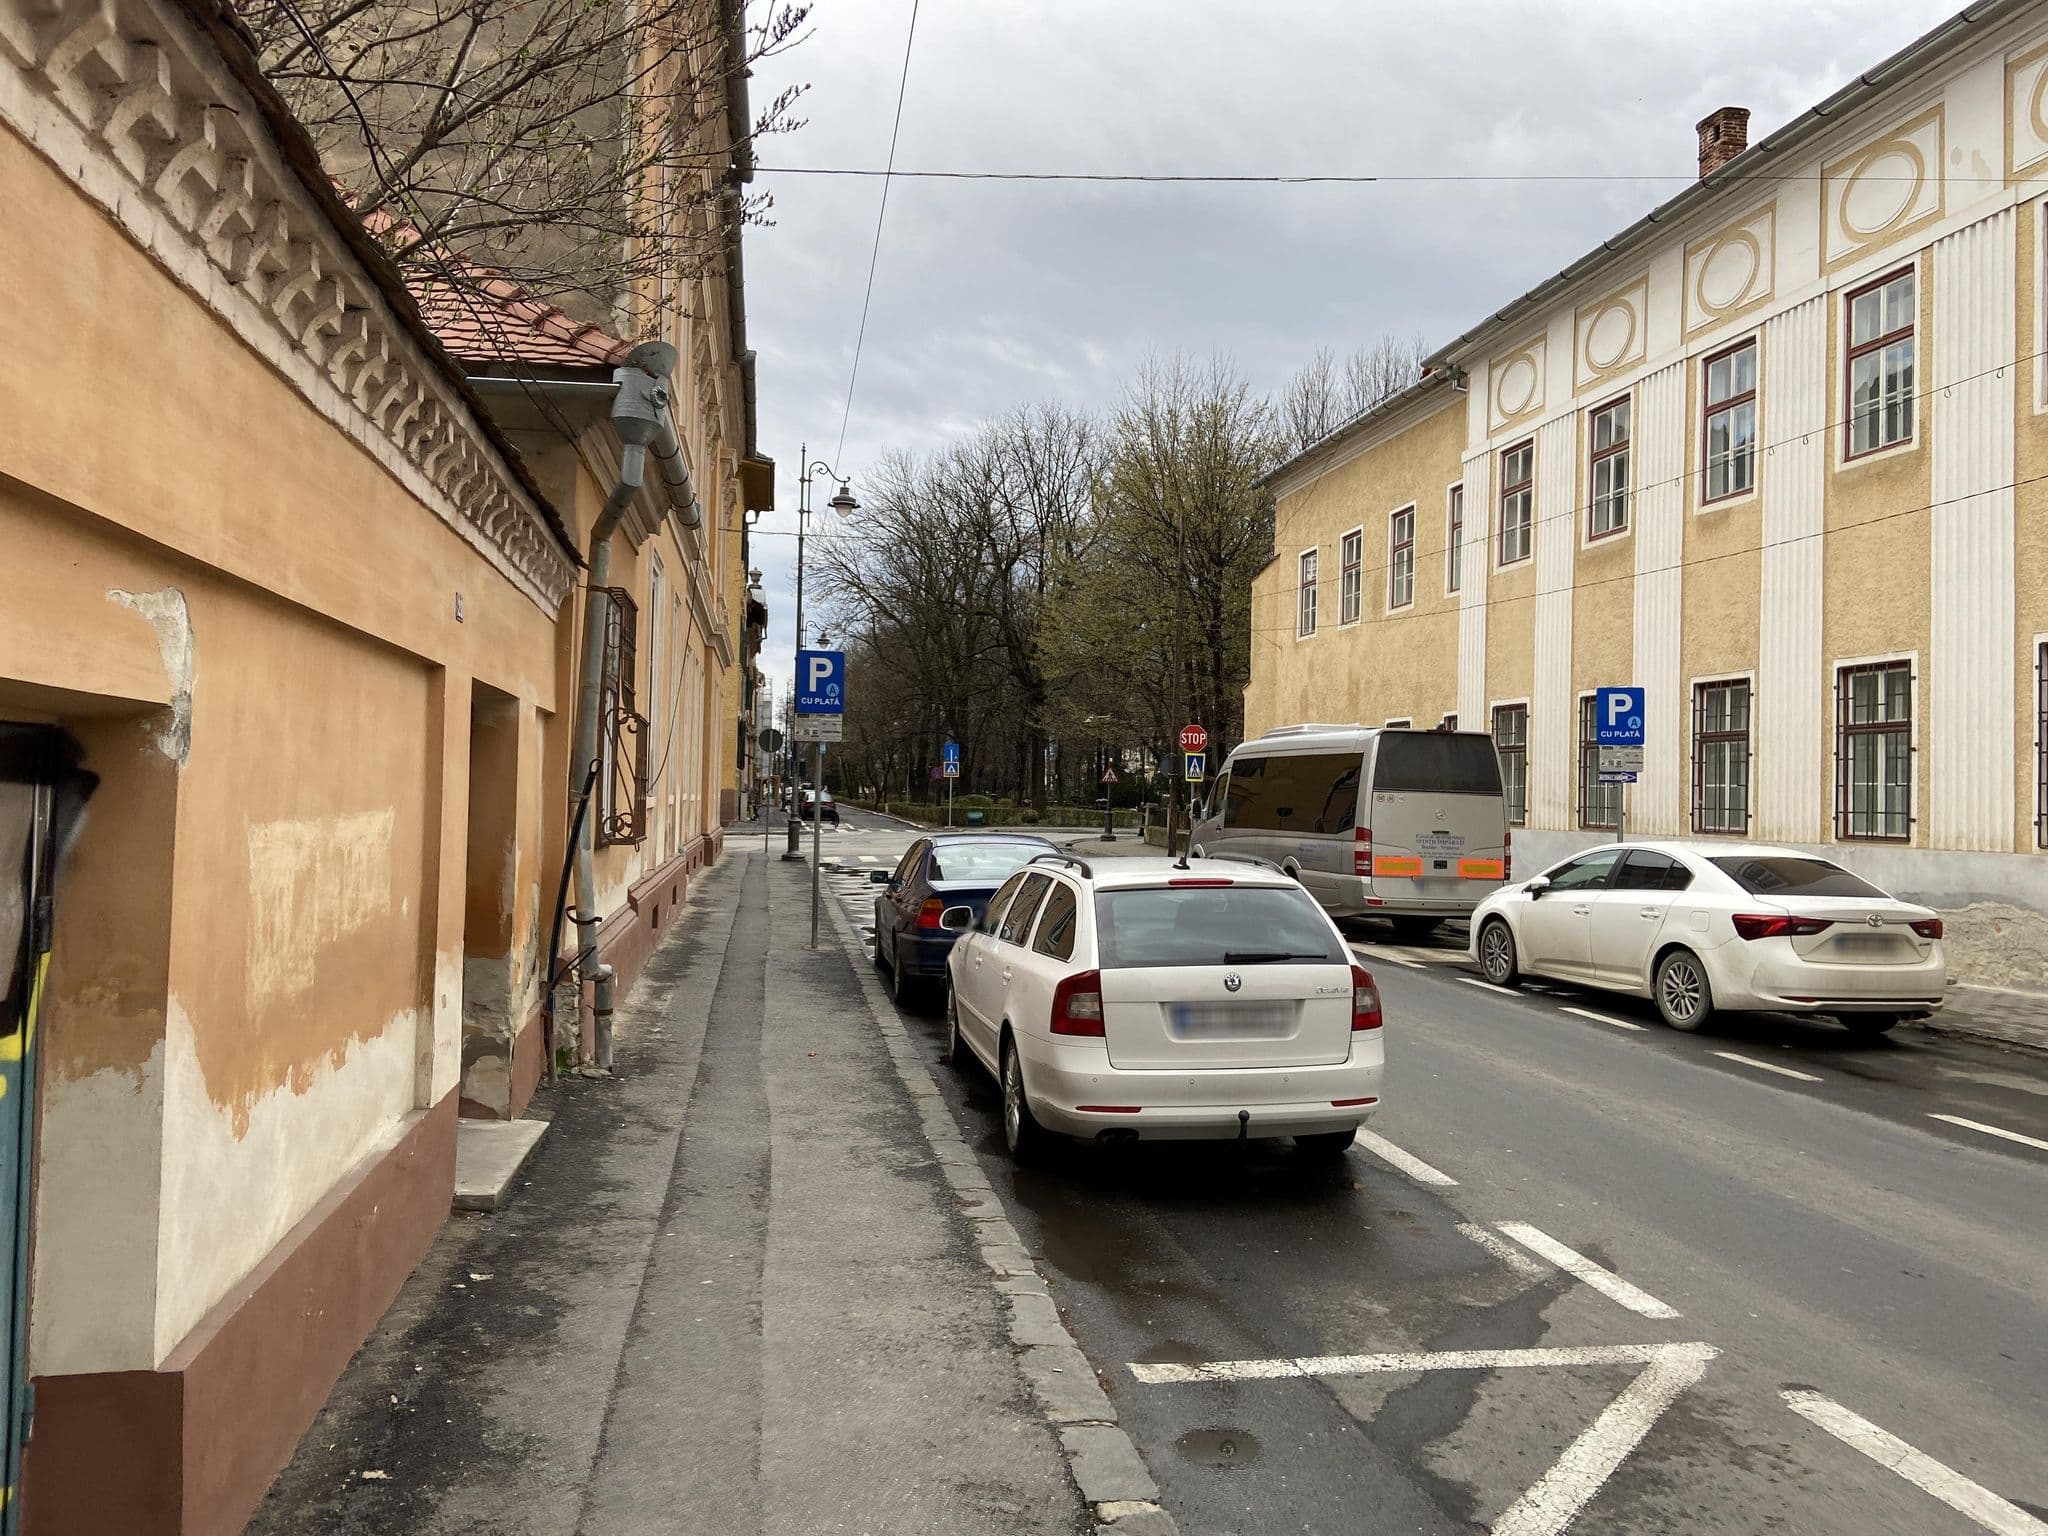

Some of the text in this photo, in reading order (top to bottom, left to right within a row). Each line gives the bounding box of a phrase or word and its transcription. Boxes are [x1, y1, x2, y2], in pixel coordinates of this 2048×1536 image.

[809, 657, 833, 692] P
[1608, 693, 1633, 726] P
[1181, 733, 1206, 744] STOP
